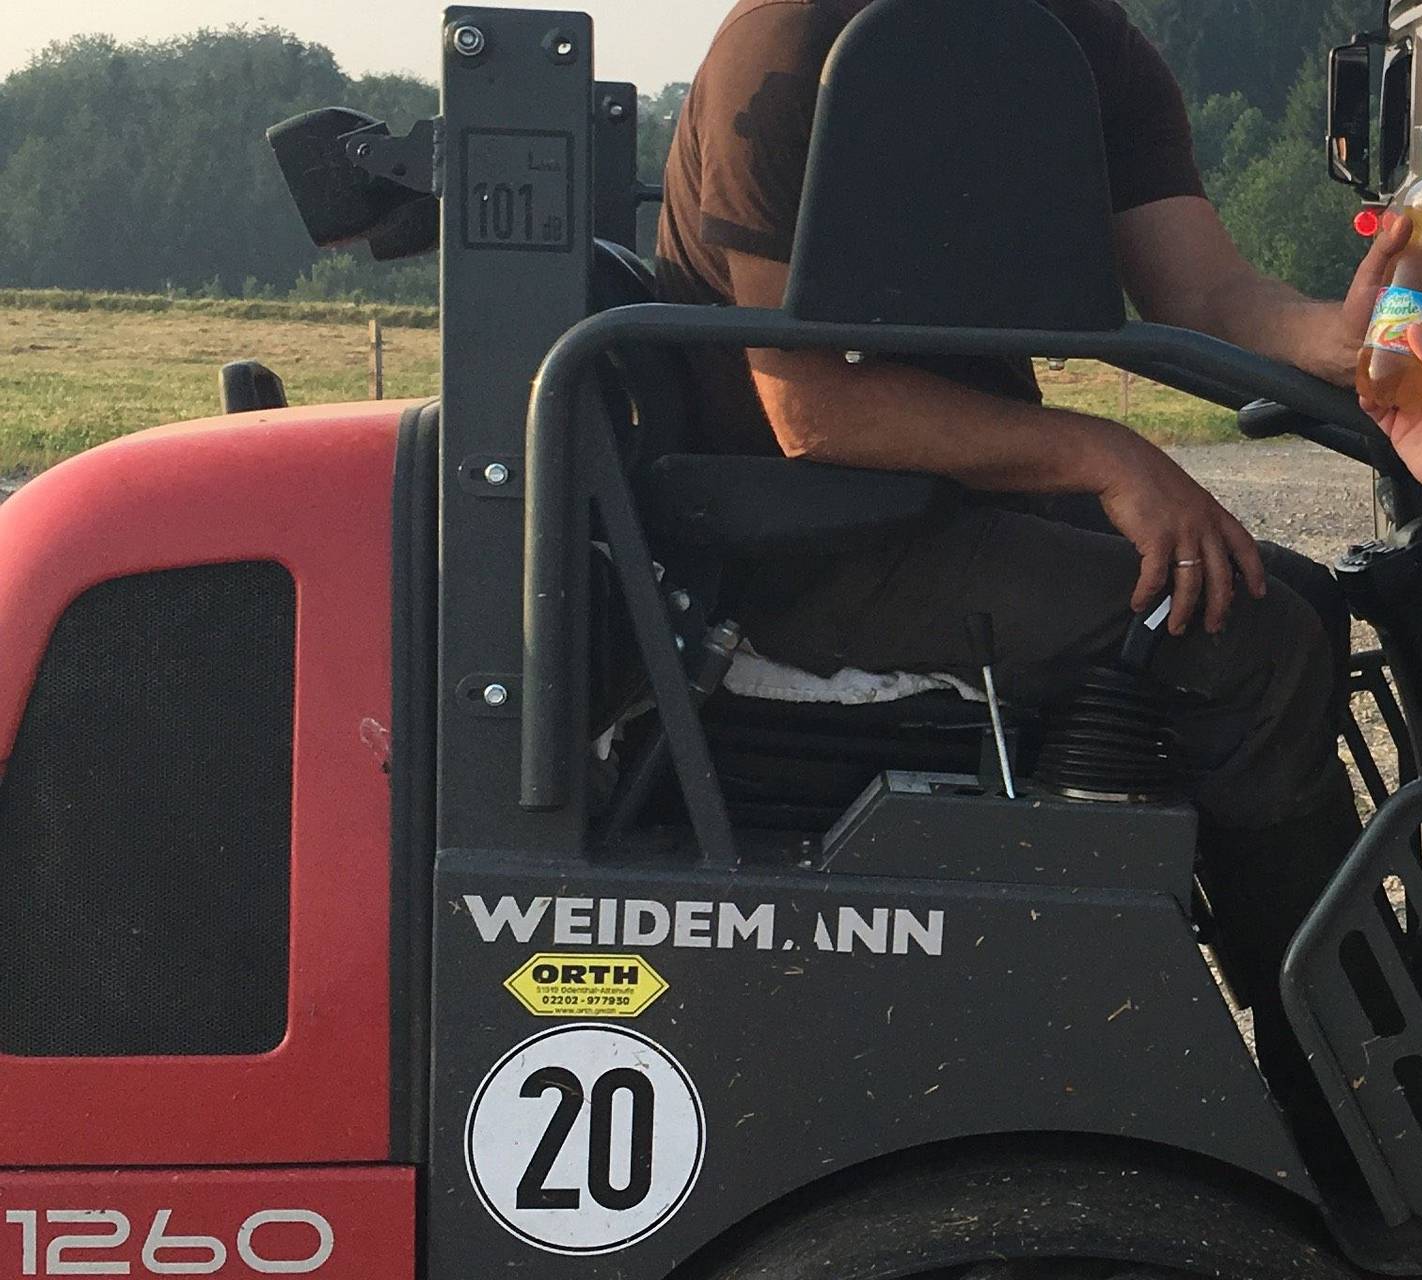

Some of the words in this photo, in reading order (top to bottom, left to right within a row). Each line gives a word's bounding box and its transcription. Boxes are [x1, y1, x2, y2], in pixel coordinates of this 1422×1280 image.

[473, 182, 533, 240] 101
[532, 964, 638, 984] ORTH
[516, 1066, 655, 1211] 20
[6, 1209, 334, 1275] 1260
